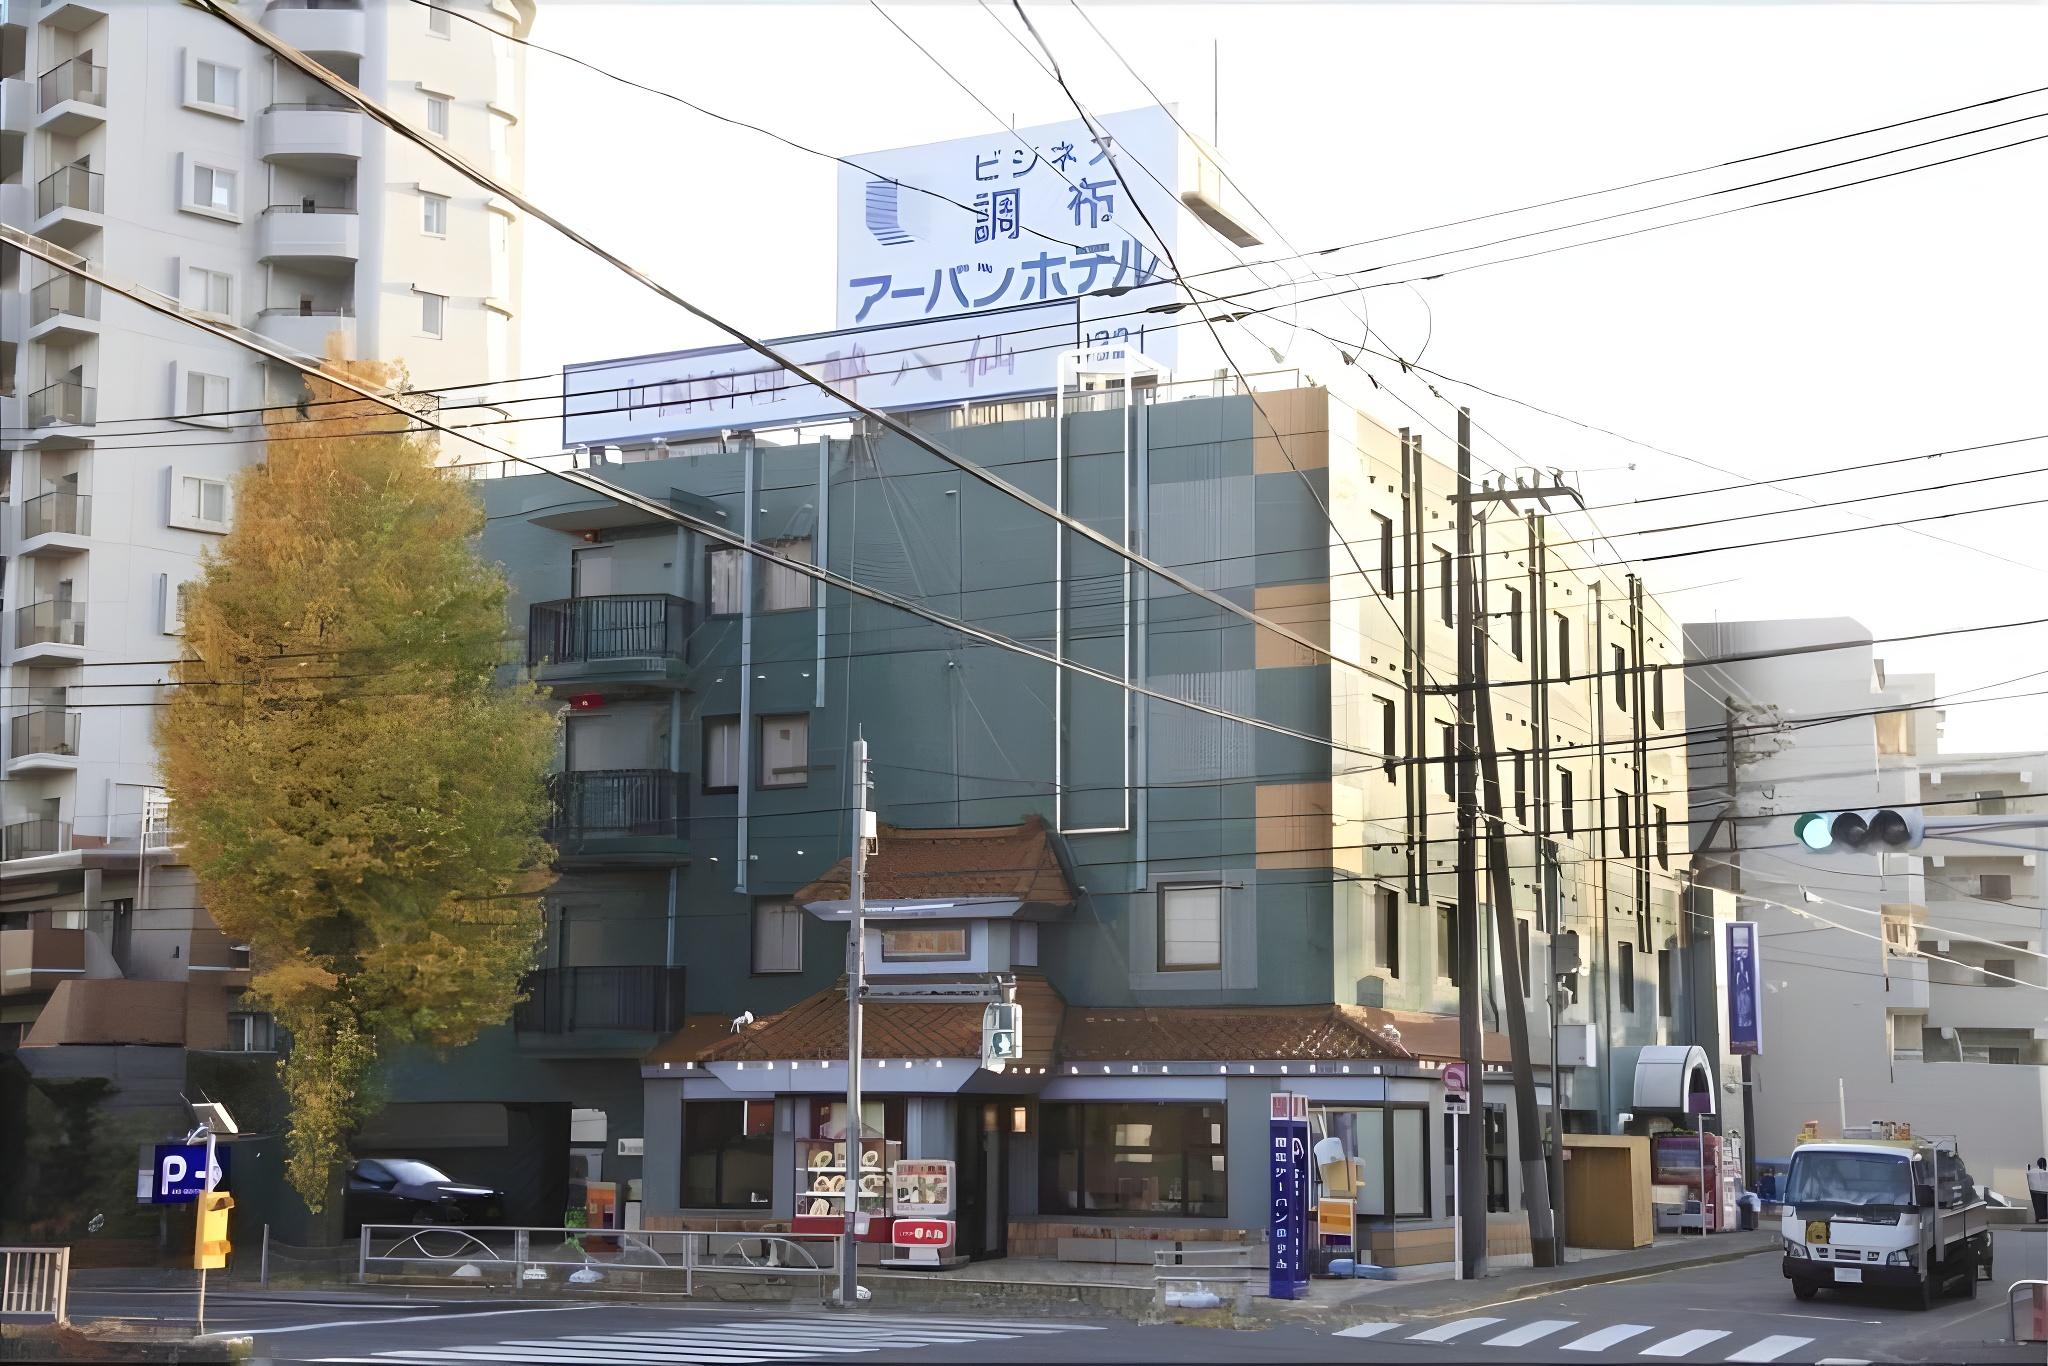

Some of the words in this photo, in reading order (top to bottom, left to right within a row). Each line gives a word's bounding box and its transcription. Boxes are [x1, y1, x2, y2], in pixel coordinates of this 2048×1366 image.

[849, 239, 1160, 324] アーバンホテル
[161, 1155, 187, 1195] P
